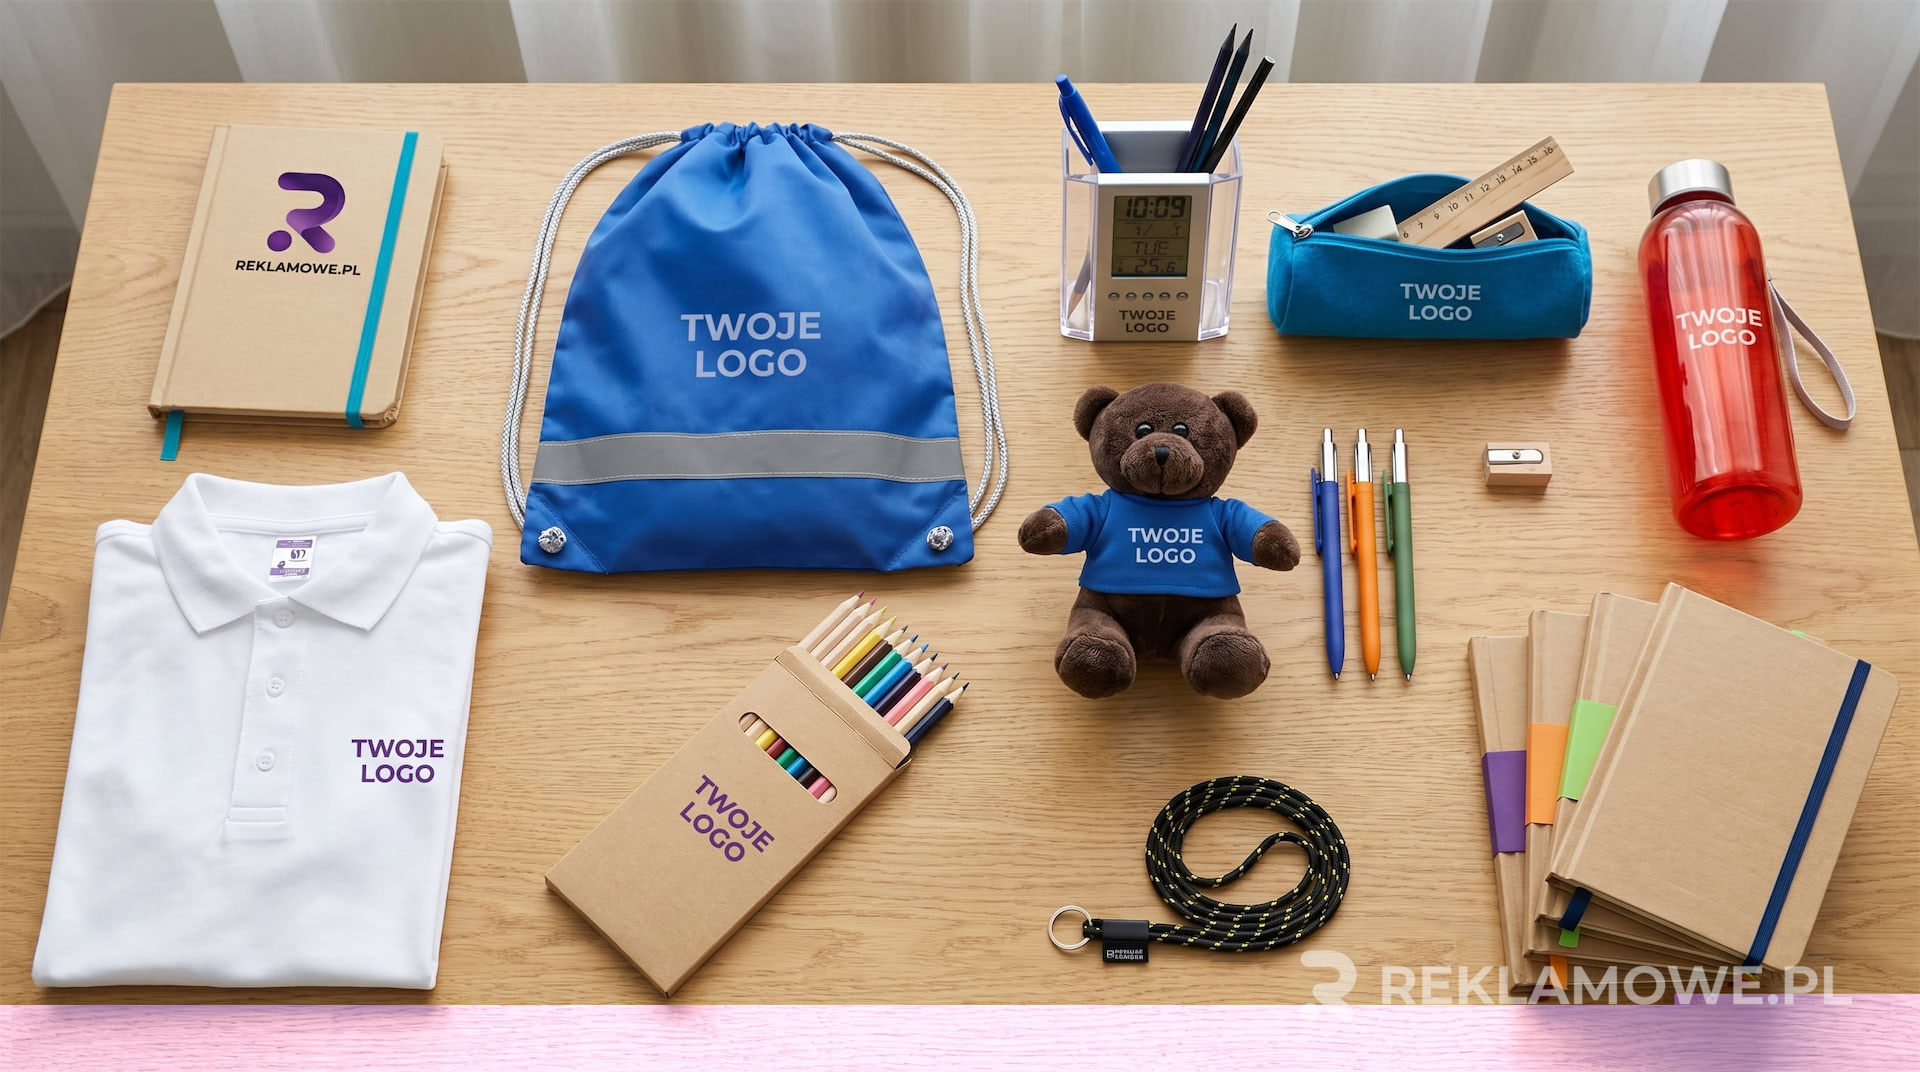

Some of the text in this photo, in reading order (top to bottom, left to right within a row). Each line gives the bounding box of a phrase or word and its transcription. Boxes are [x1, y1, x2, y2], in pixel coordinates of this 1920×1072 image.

[1448, 202, 1458, 212] 10
[1465, 193, 1474, 202] 11
[1480, 183, 1491, 193] 12
[1512, 165, 1522, 174] 14
[1527, 156, 1538, 165] 15
[1543, 146, 1554, 156] 16
[1126, 197, 1186, 219] 10:09
[1132, 240, 1170, 256] TUE
[235, 260, 361, 276] REKLAMOWE.PL
[1135, 258, 1176, 273] 25.6
[1400, 283, 1481, 301] TWOJE
[1119, 310, 1176, 320] TWOJE
[1409, 304, 1472, 321] LOGO
[1676, 307, 1763, 330] TWOJE
[680, 311, 822, 342] TWOJE
[1126, 323, 1169, 333] LOGO
[1688, 328, 1756, 350] LOGO
[696, 348, 807, 378] LOGO
[1127, 527, 1204, 544] TWOJE
[1136, 547, 1196, 564] LOGO
[351, 739, 444, 758] TWOJE
[361, 764, 435, 783] LOGO
[695, 774, 775, 853] TWOJE
[680, 801, 745, 862] LOGO
